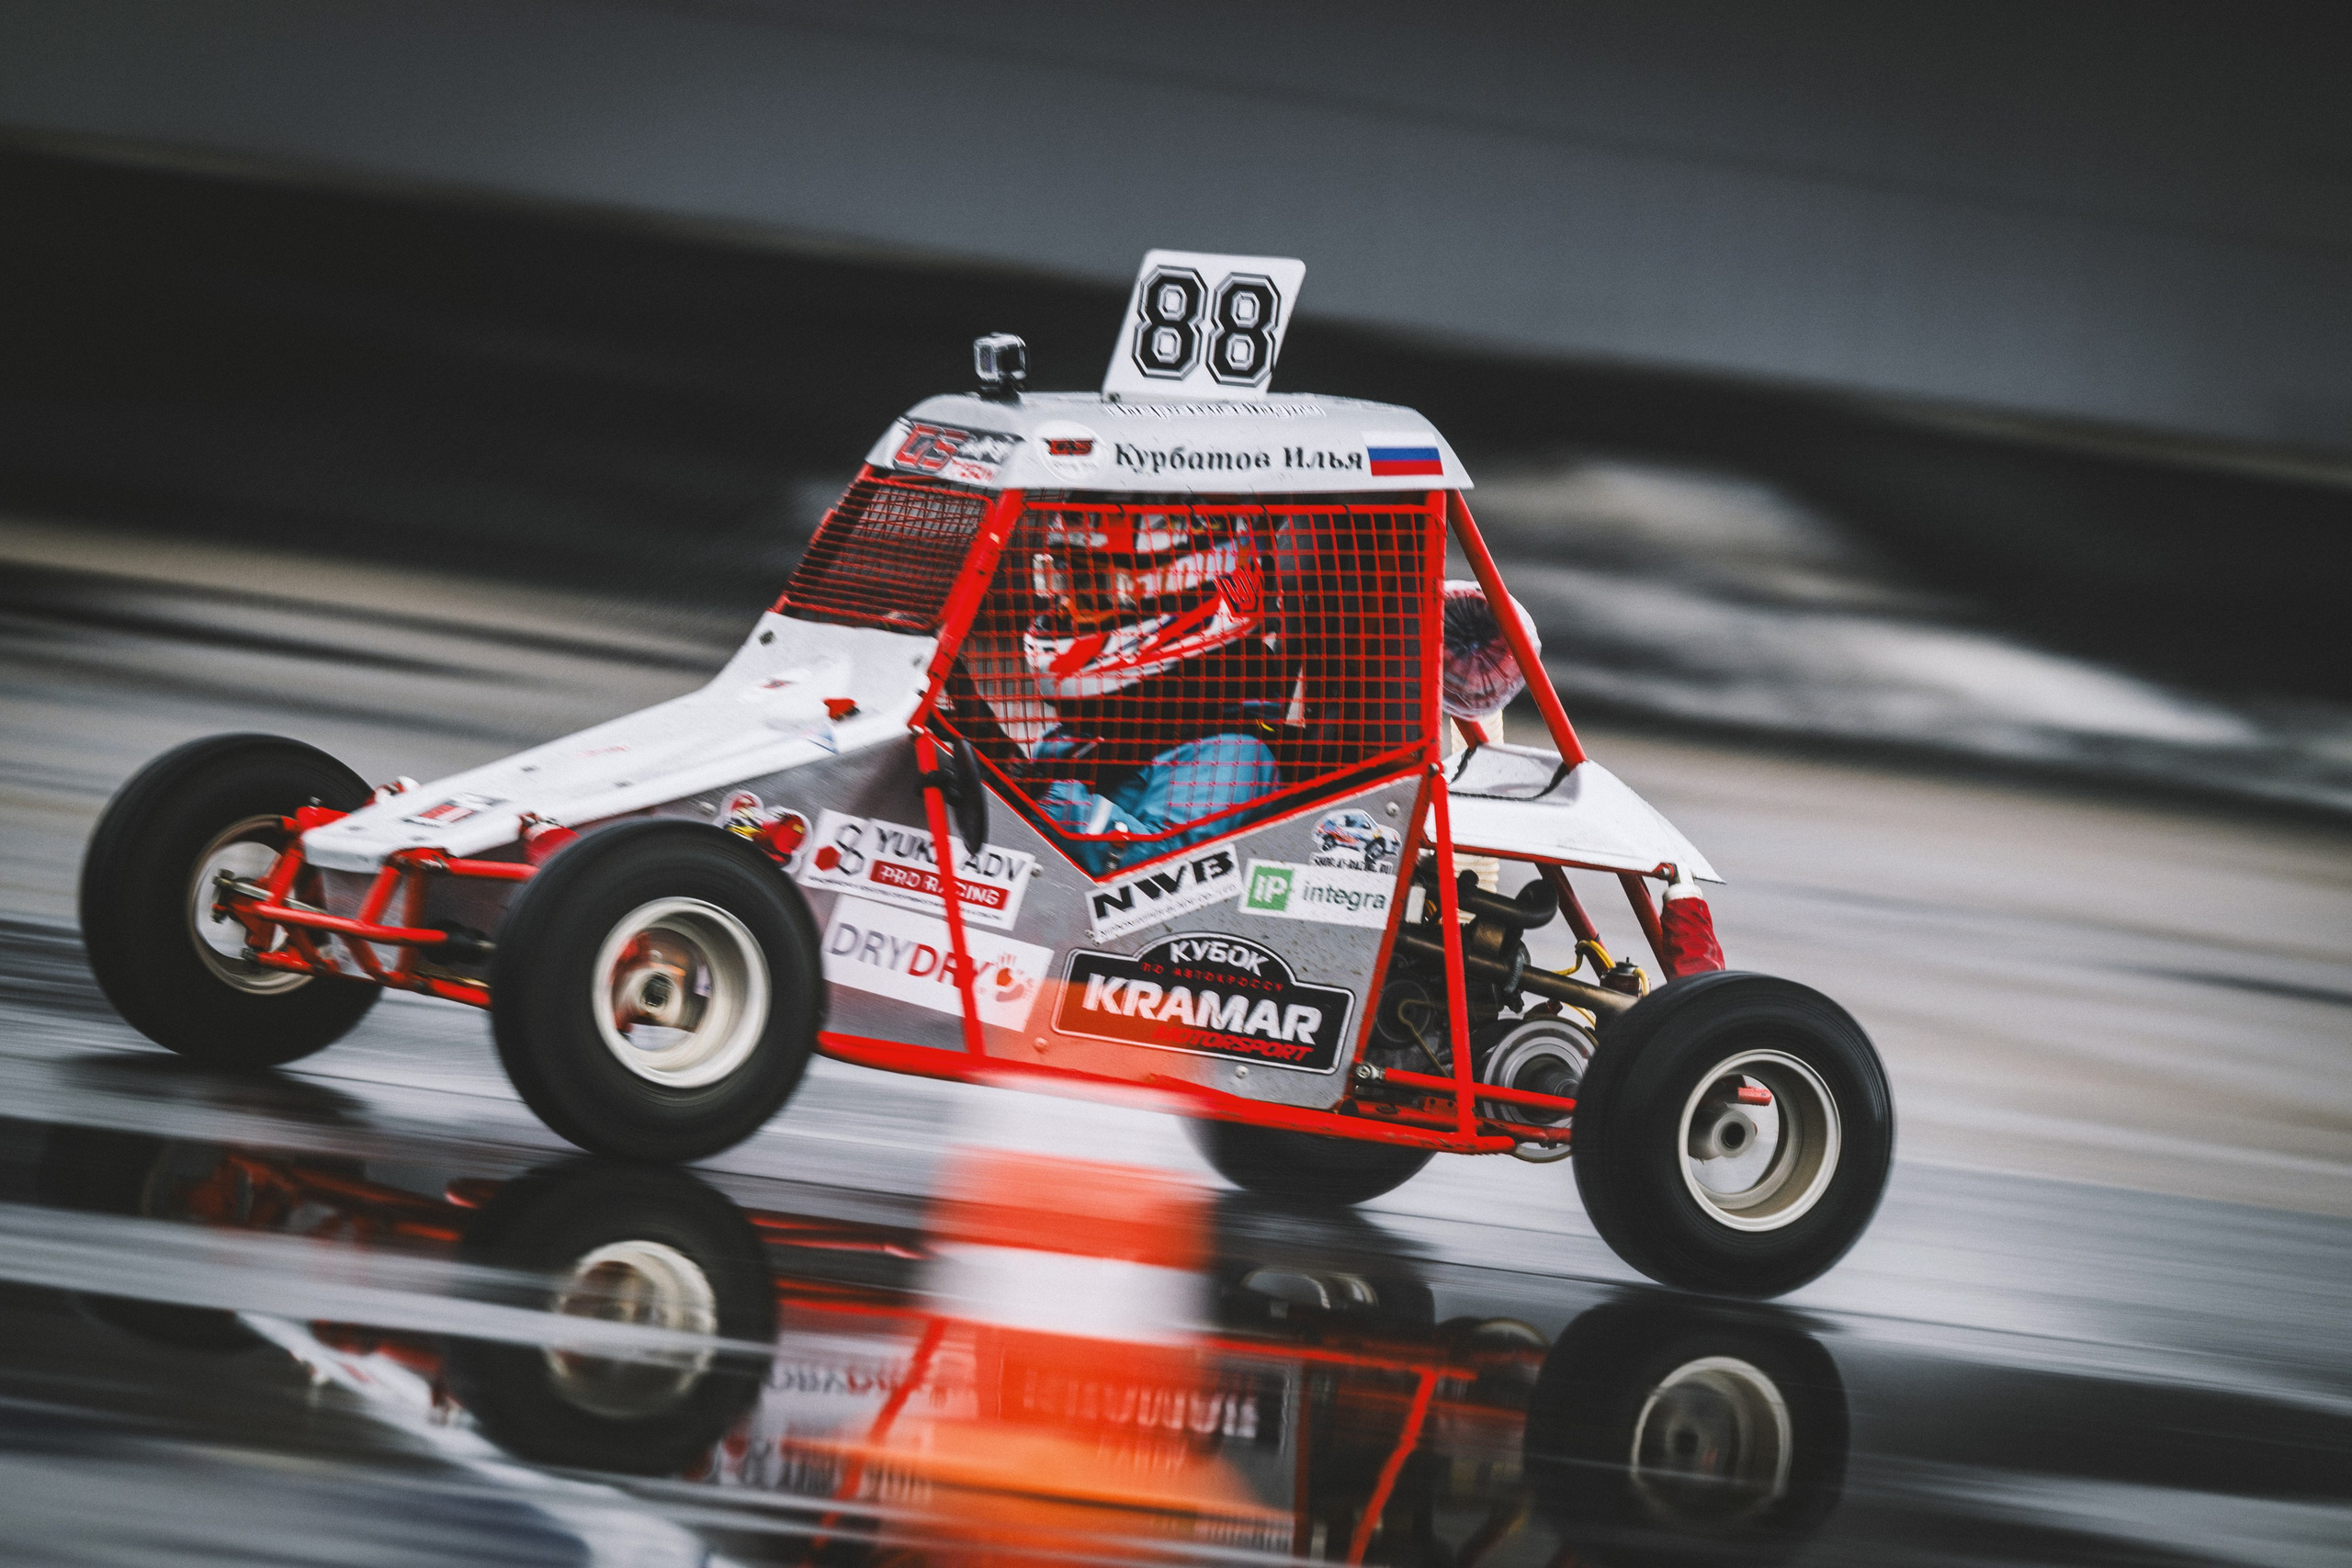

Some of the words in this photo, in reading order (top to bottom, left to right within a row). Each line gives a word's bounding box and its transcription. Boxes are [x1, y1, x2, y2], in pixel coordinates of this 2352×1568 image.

[1131, 265, 1283, 388] 88
[1114, 443, 1272, 474] Курбатов
[1283, 446, 1363, 471] Илья
[878, 865, 922, 888] PRO
[1092, 851, 1234, 919] NWB
[1303, 881, 1387, 911] integra
[1170, 940, 1270, 976] КУБОК
[1082, 972, 1322, 1045] KRAMAR
[1151, 1025, 1314, 1062] MOTORSPORT
